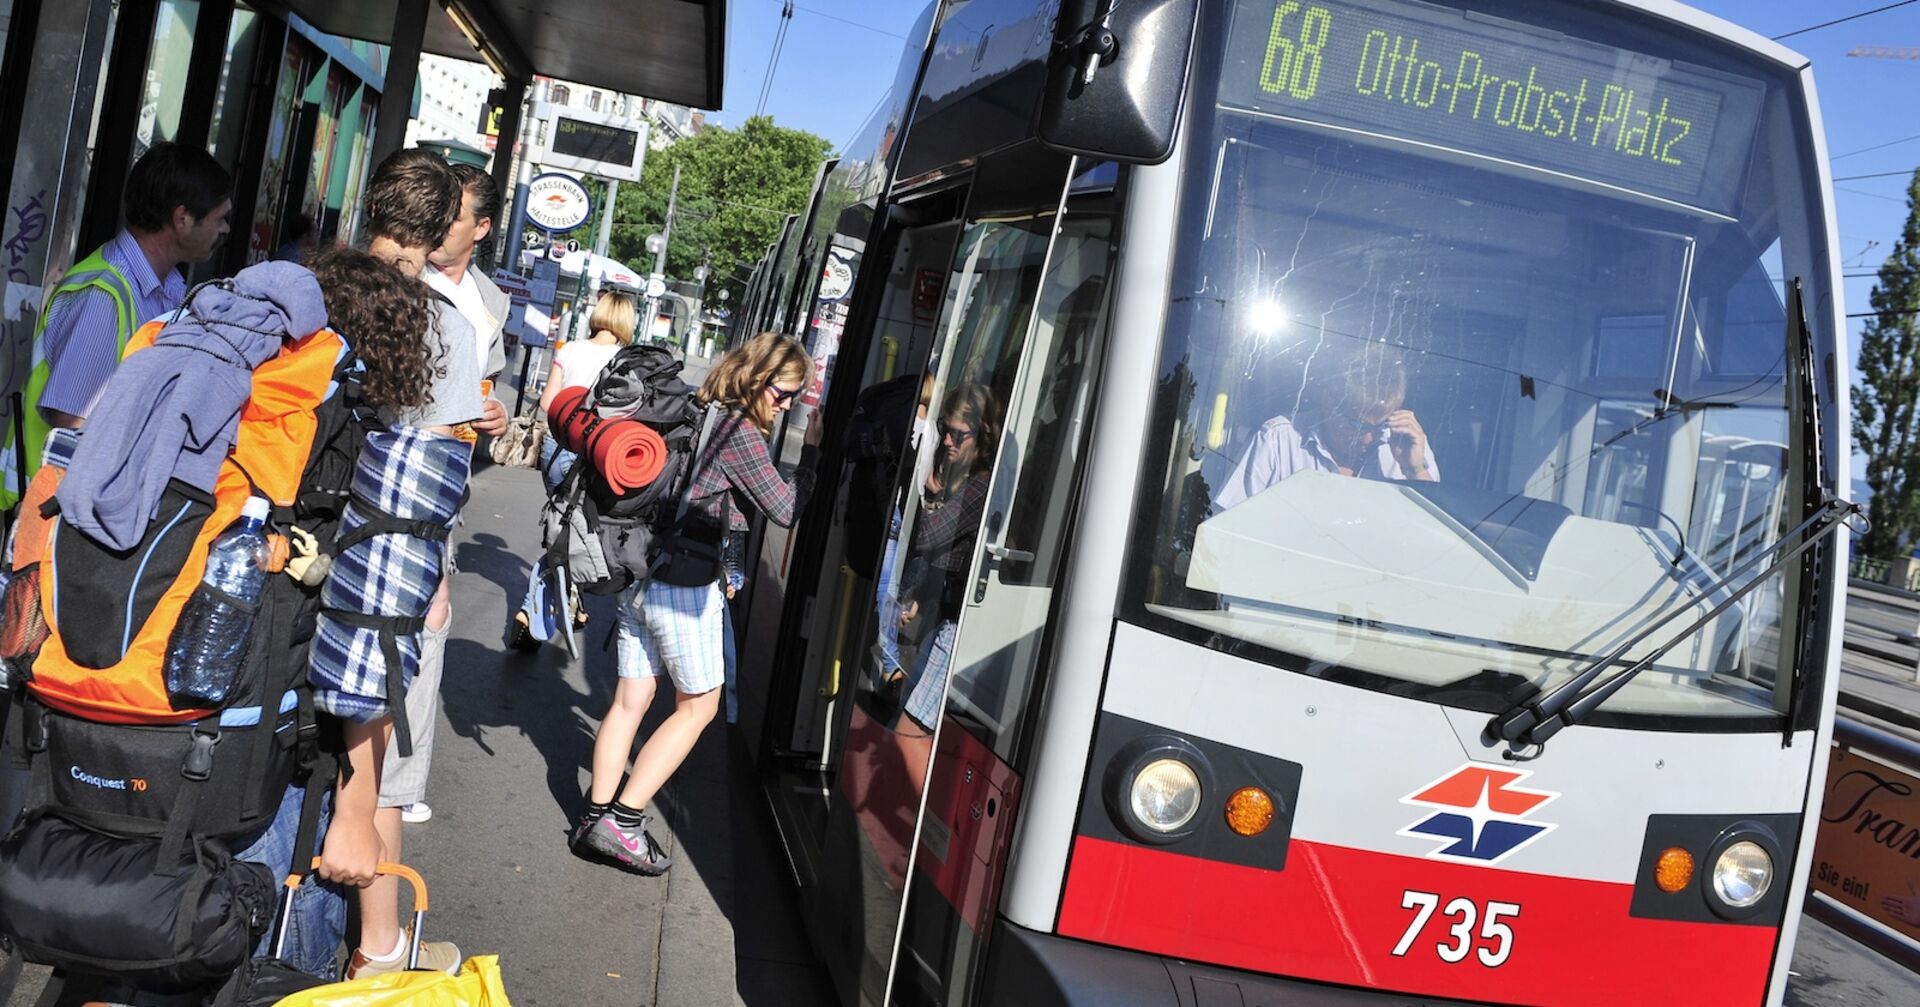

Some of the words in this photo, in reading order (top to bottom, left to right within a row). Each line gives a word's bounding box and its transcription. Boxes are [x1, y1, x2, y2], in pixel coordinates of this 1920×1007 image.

[1259, 1, 1332, 100] 68
[1355, 29, 1692, 166] Otto-Probst-Platz
[532, 181, 584, 203] STRASSENBAHN
[530, 206, 579, 226] HALTESTELLE
[528, 234, 538, 245] 2
[570, 242, 577, 253] 1
[71, 766, 126, 788] Conquest
[131, 779, 147, 791] 70
[1818, 862, 1839, 886] Sie
[1842, 877, 1870, 901] ein!
[1390, 888, 1522, 968] 735
